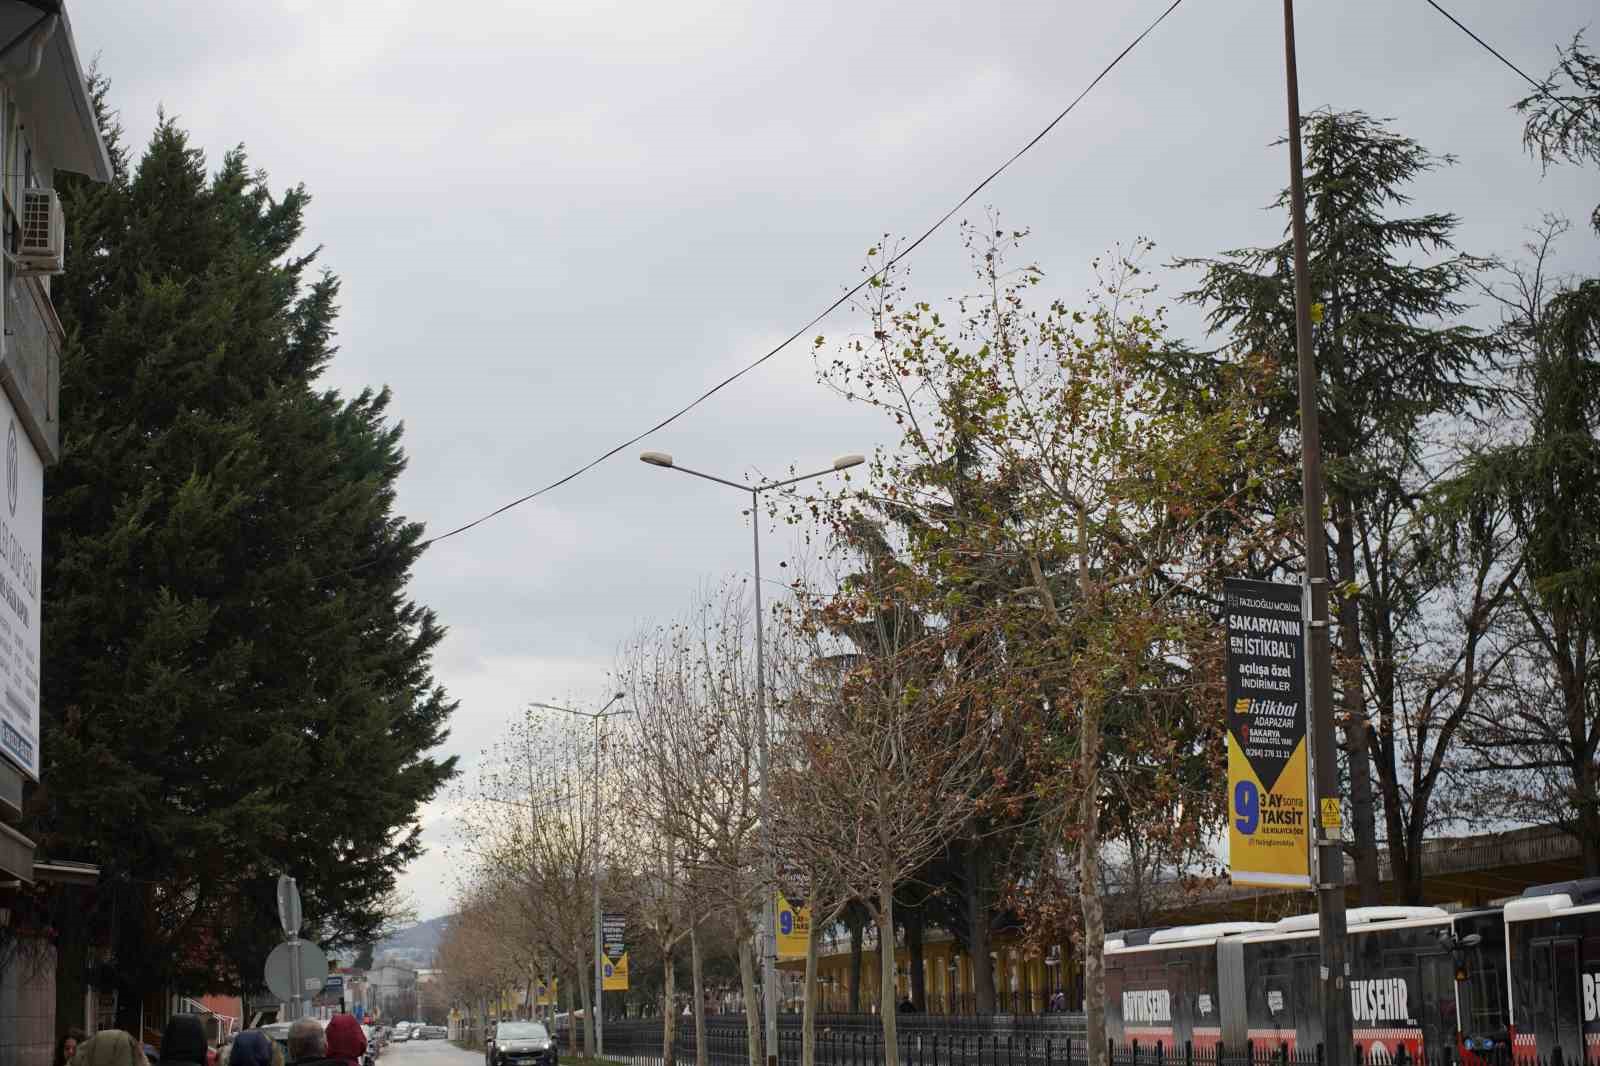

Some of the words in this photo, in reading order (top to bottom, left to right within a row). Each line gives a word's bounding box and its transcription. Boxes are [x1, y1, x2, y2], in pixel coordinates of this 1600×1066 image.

[1229, 614, 1300, 636] SAKARYA'NIN
[1230, 636, 1243, 647] EN
[1239, 662, 1269, 677] açılışa
[1271, 663, 1292, 678] özel
[1241, 676, 1290, 691] İNDİRİMLER
[1249, 698, 1298, 717] istikbal
[1254, 716, 1294, 729] ADAPAZARI
[1249, 728, 1280, 738] SAKARYA
[1235, 780, 1259, 834] 9
[1260, 793, 1267, 807] 3
[1269, 794, 1283, 807] AY
[1282, 797, 1303, 807] sonra
[1260, 807, 1303, 825] TAKSİT
[1123, 990, 1171, 1026] BÜYÜKŞEHİR
[1350, 978, 1408, 1026] ÜKŞEHİR
